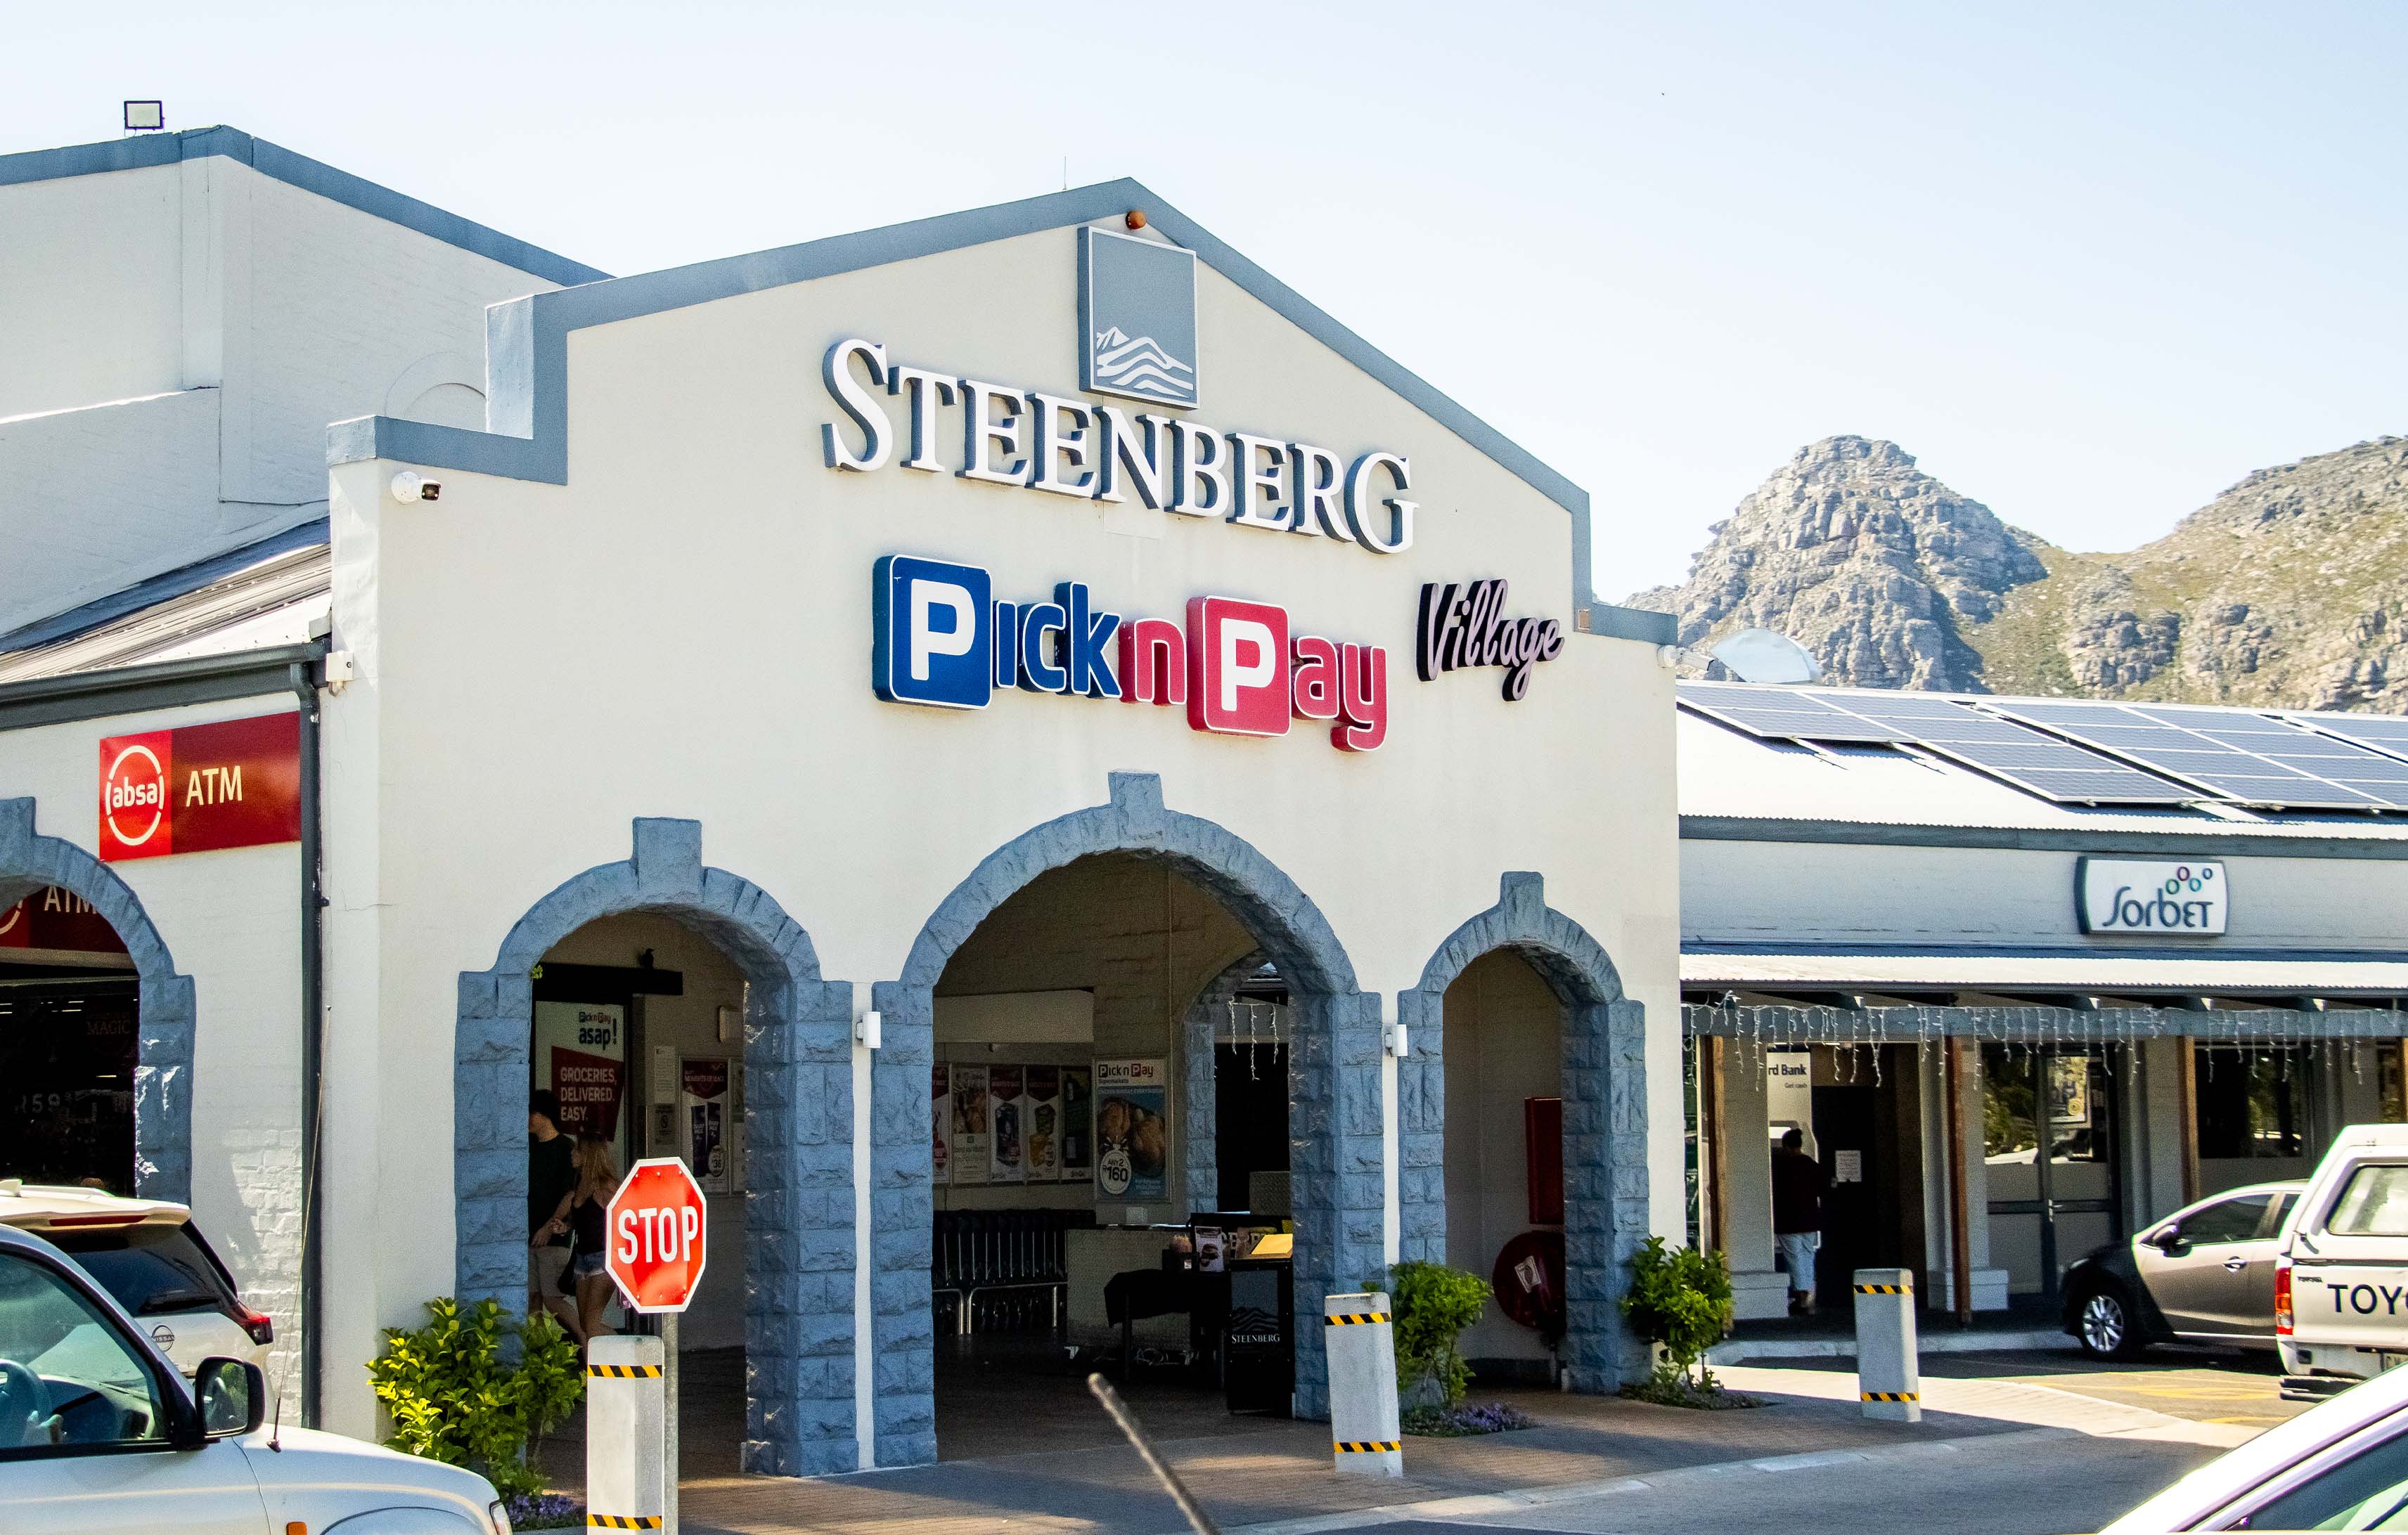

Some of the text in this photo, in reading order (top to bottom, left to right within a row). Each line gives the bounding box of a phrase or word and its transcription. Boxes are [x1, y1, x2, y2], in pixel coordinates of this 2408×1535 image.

[823, 339, 1419, 555] STEENBERG
[1417, 579, 1564, 701] Village
[112, 777, 159, 808] absa
[186, 765, 243, 808] ATM
[579, 1018, 617, 1051] asap!
[560, 1067, 617, 1085] GROCERIES,
[1098, 1063, 1154, 1078] Pick n Pay
[1782, 1063, 1807, 1075] Bank
[560, 1087, 614, 1102] DELIVERED.
[560, 1106, 588, 1122] EASY.
[618, 1205, 698, 1264] STOP
[2327, 1283, 2408, 1315] TOY
[1231, 1333, 1280, 1344] STEENBERG
